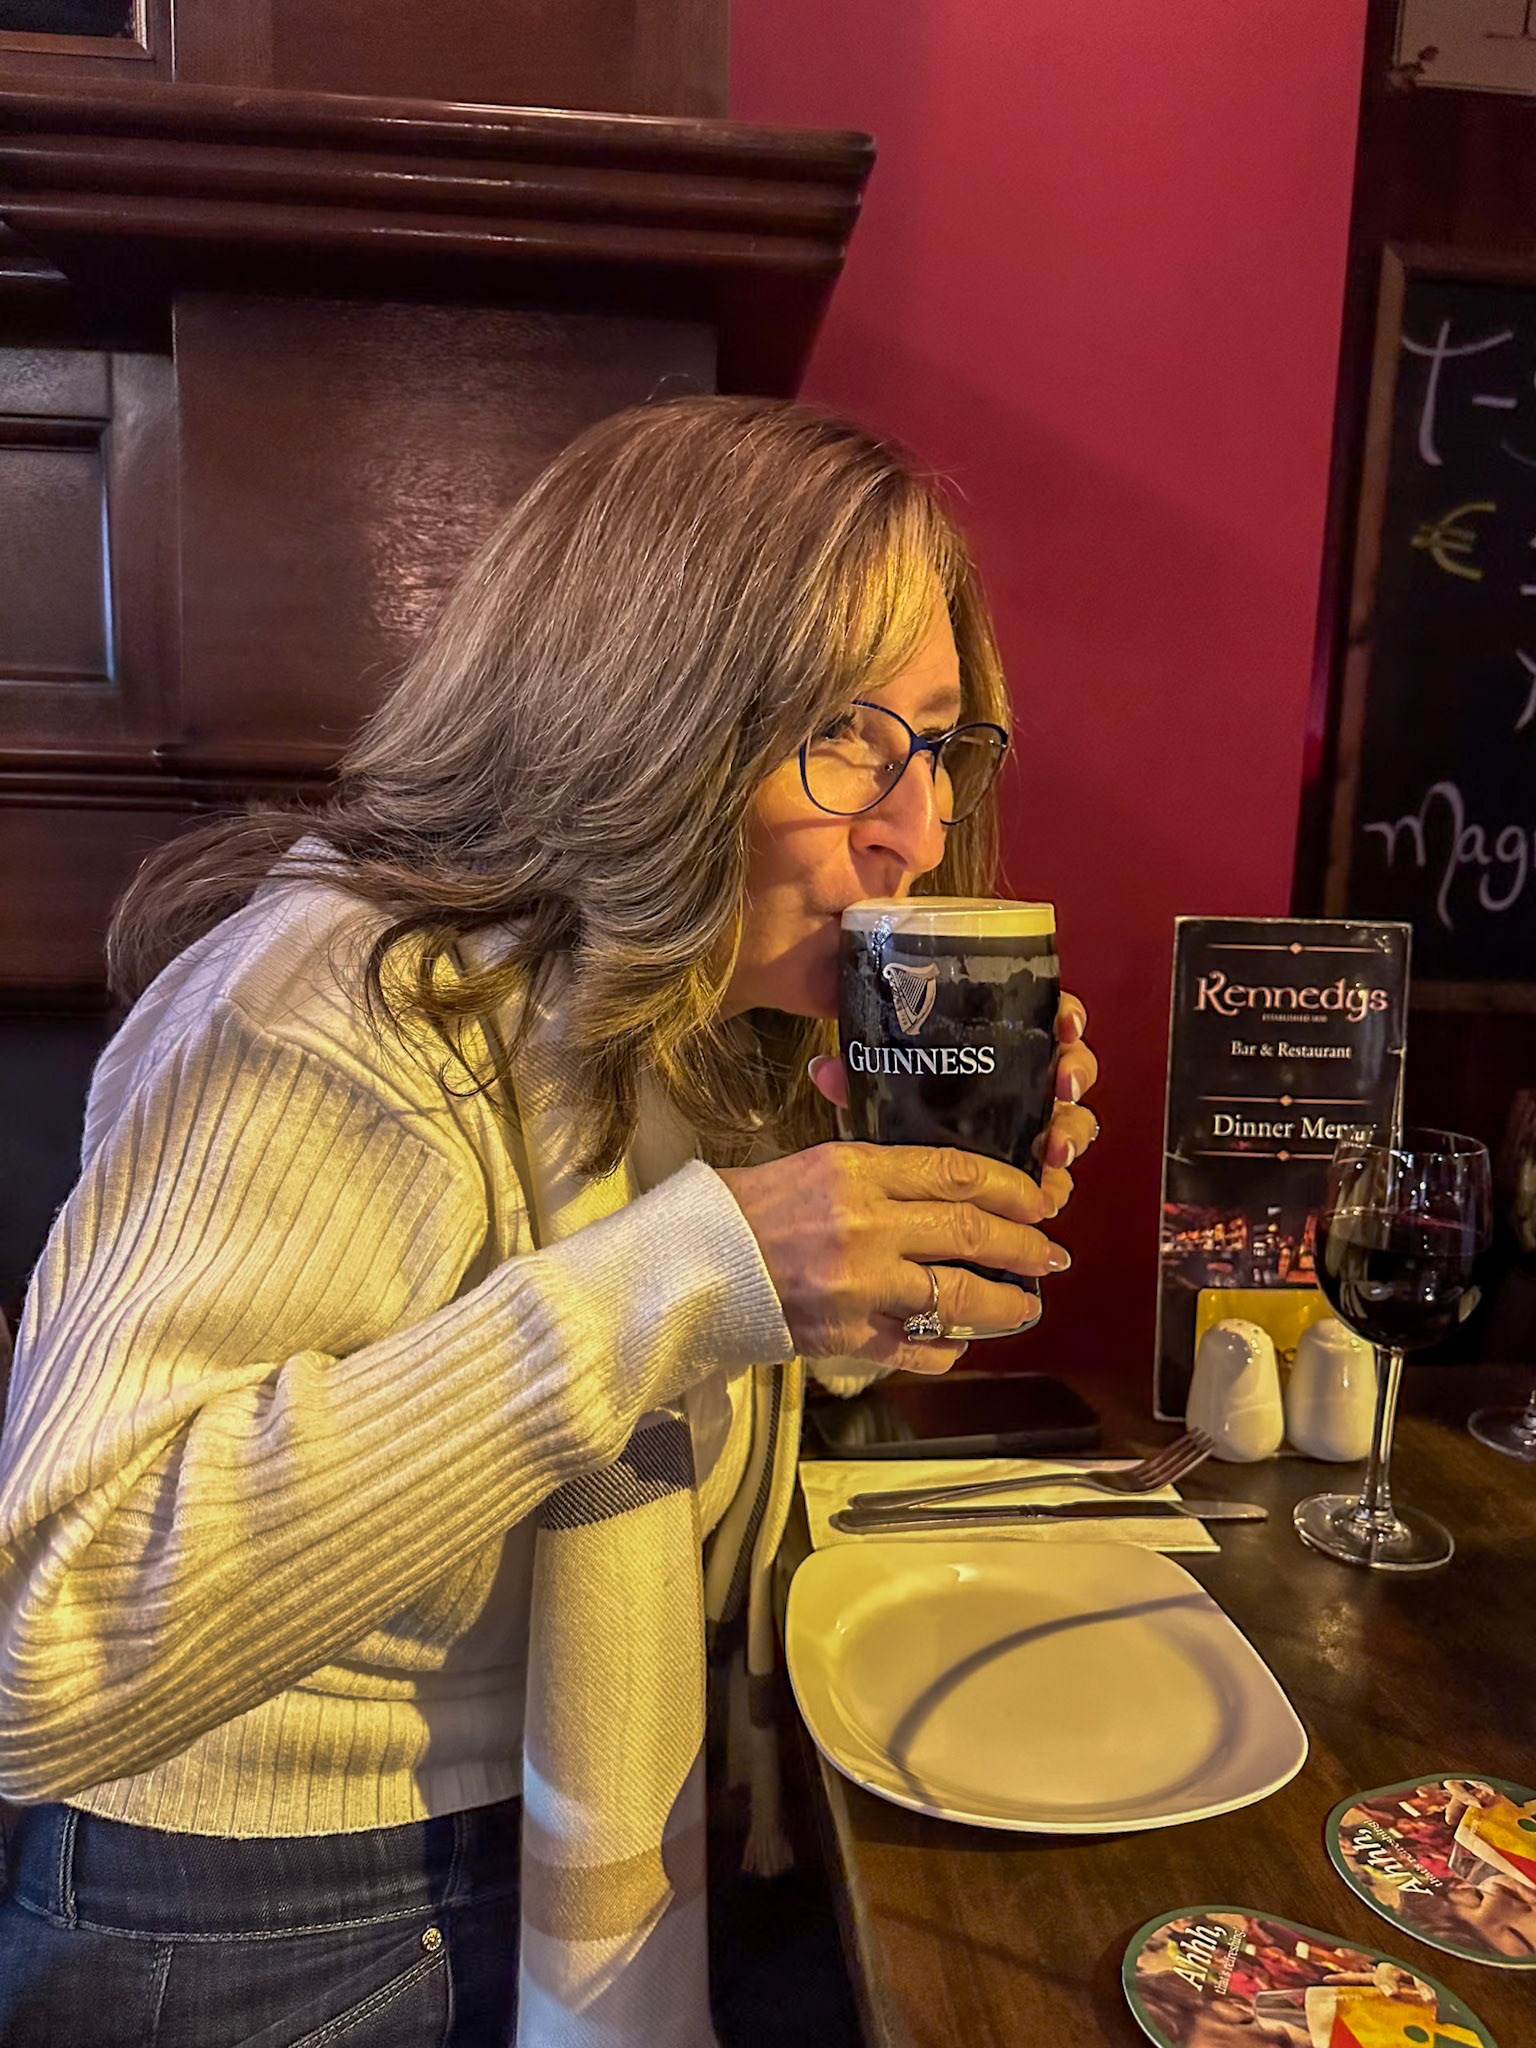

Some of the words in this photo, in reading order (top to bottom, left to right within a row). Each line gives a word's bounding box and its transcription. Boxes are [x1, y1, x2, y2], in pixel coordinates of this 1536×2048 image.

[1363, 780, 1536, 931] Mag
[1194, 970, 1388, 1022] Kennedys
[849, 1041, 995, 1075] GUINNESS
[1231, 1040, 1256, 1056] Bar
[1259, 1042, 1273, 1057] &
[1278, 1042, 1352, 1059] Restaurant
[1213, 1114, 1295, 1138] Dinner
